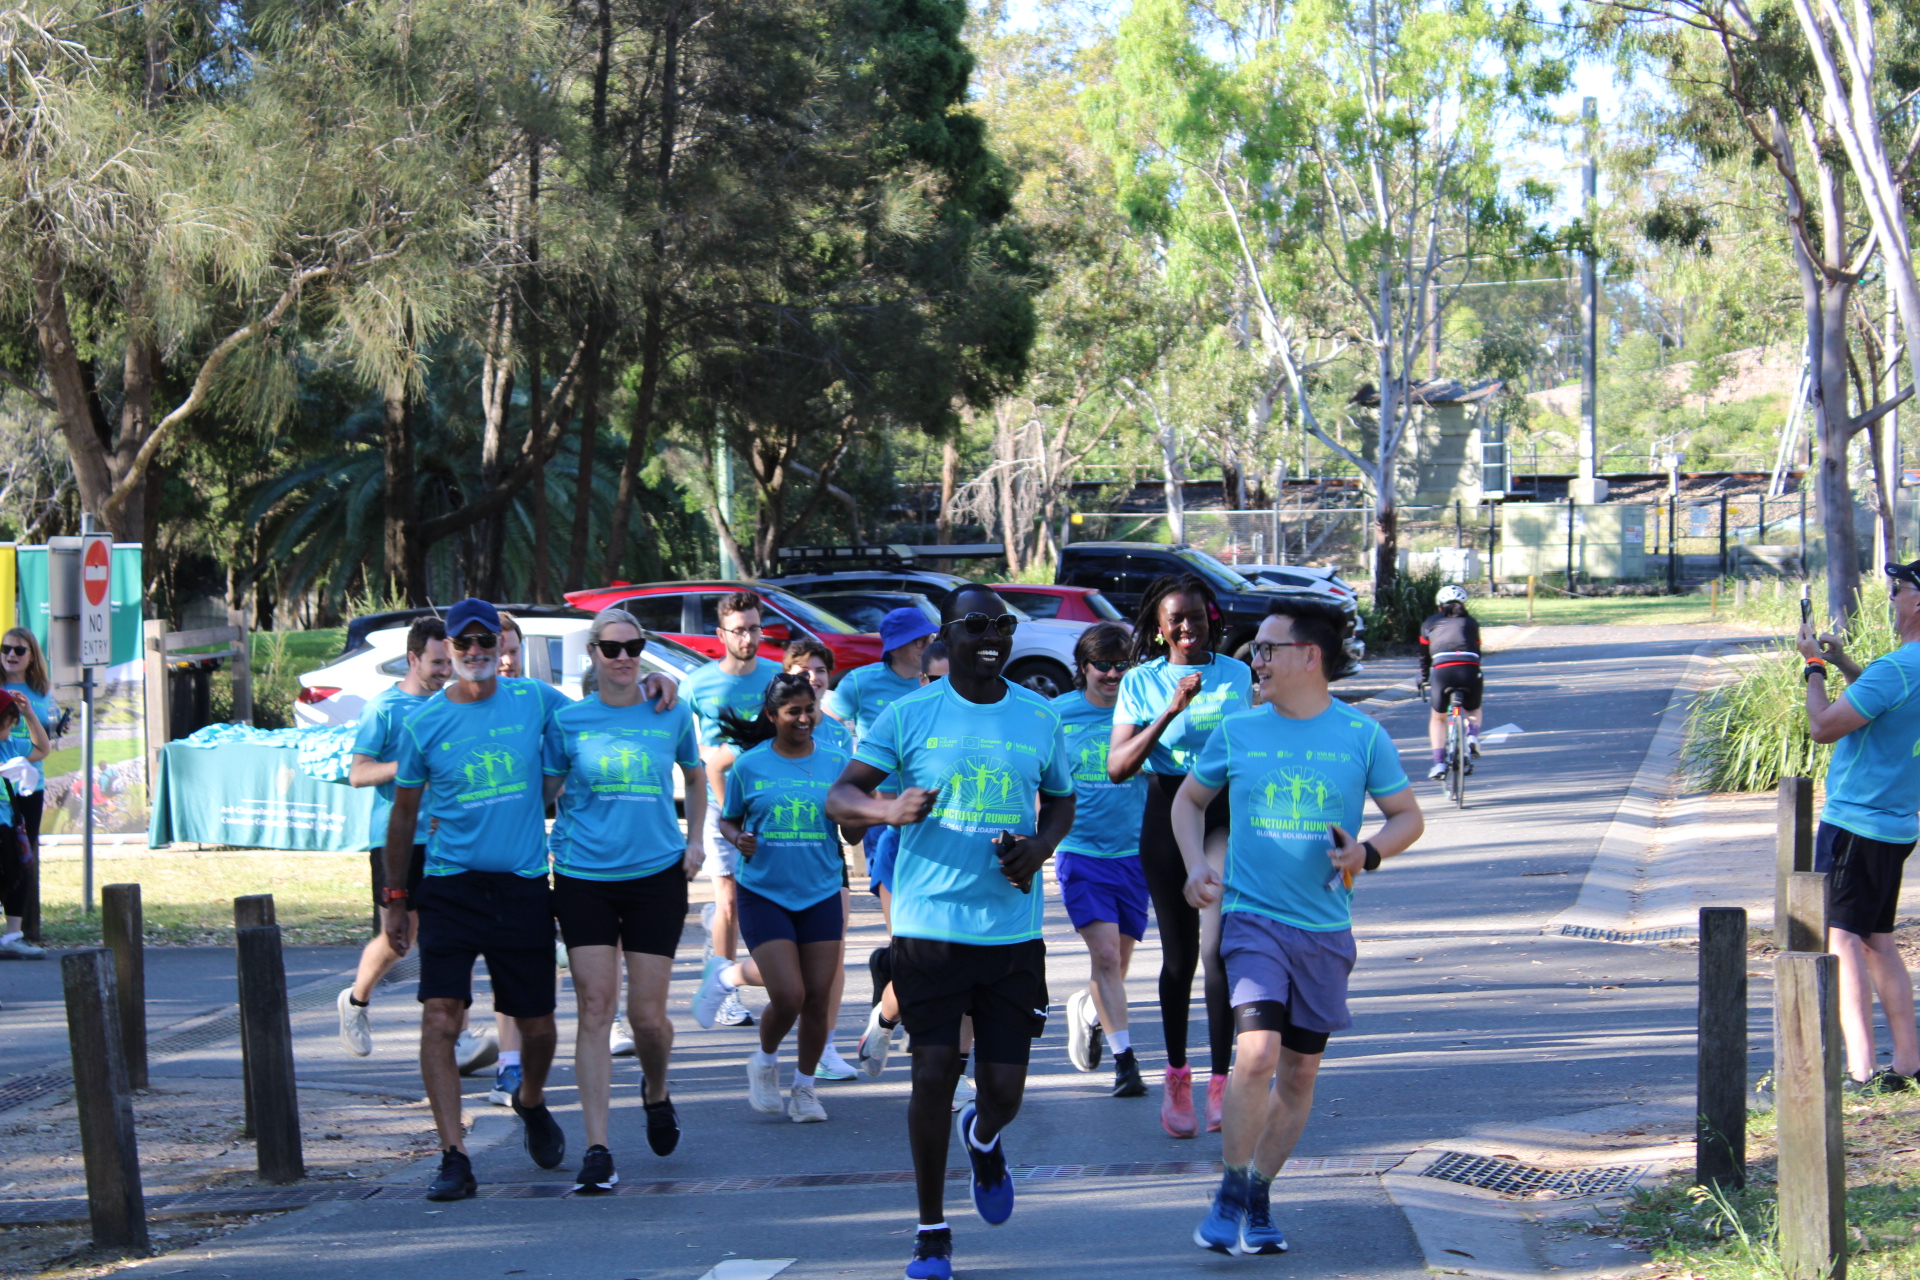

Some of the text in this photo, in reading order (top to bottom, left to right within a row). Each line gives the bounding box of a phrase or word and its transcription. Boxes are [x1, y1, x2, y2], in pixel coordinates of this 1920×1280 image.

[89, 614, 103, 632] NO
[84, 640, 108, 655] ENTRY
[1073, 773, 1106, 781] SANCTUARY
[456, 781, 528, 802] SANCTUARY RUNNERS
[589, 783, 662, 795] SANCTUARY RUNNERS
[931, 807, 1022, 824] SANCTUARY RUNNERS
[939, 821, 963, 832] GLOBAL
[1250, 816, 1301, 831] SANCTUARY
[762, 831, 827, 840] SANCTUARY RUNNERS
[1256, 829, 1281, 839] GLOBAL
[1282, 831, 1323, 841] SOLIDARITY
